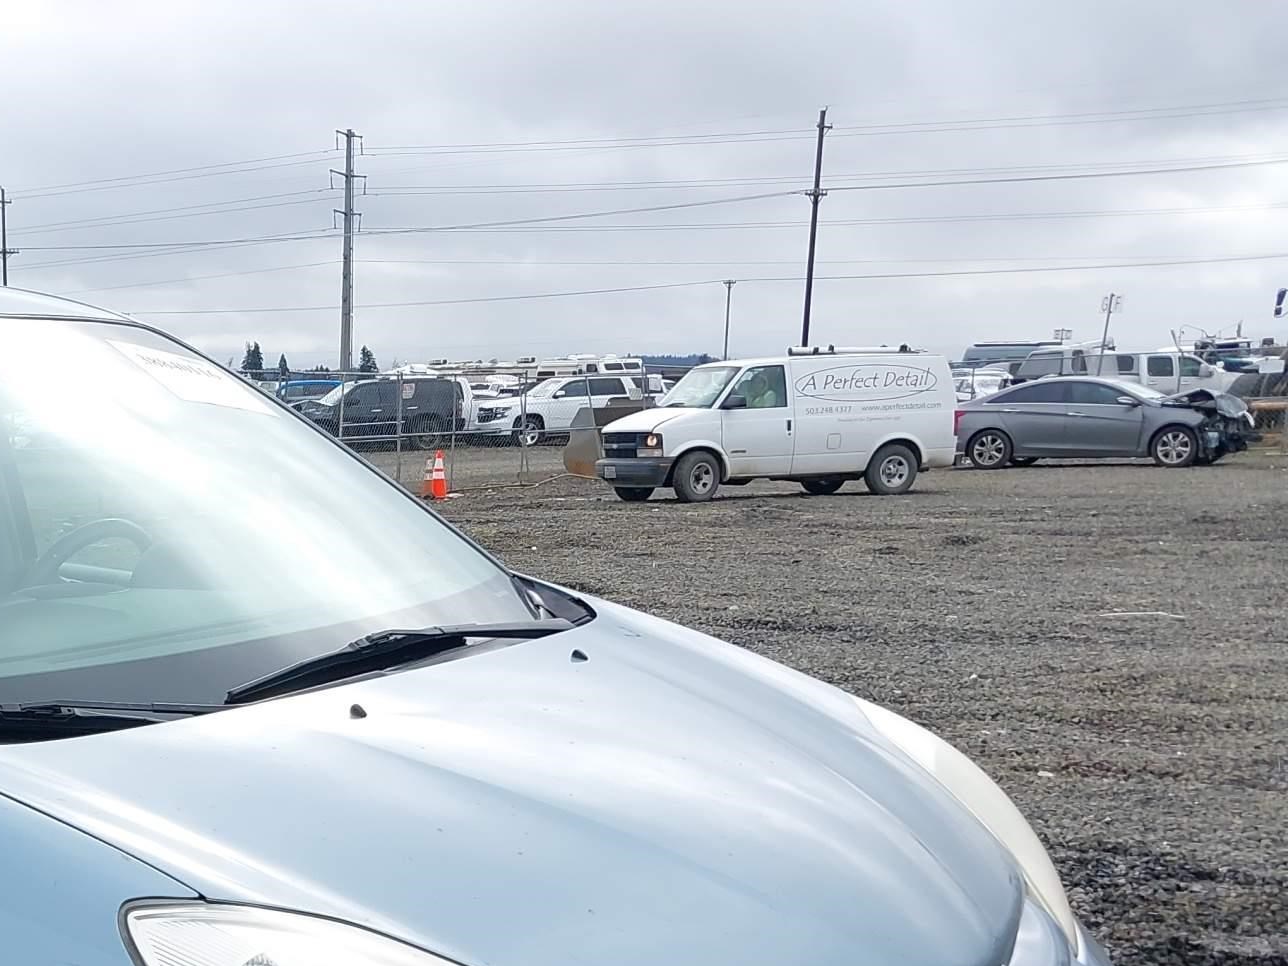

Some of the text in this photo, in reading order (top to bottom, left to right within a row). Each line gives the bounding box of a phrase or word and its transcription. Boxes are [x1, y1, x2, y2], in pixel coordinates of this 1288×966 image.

[801, 368, 930, 391] A Perfect Detail
[861, 402, 942, 412] www.aperfectdetail.com
